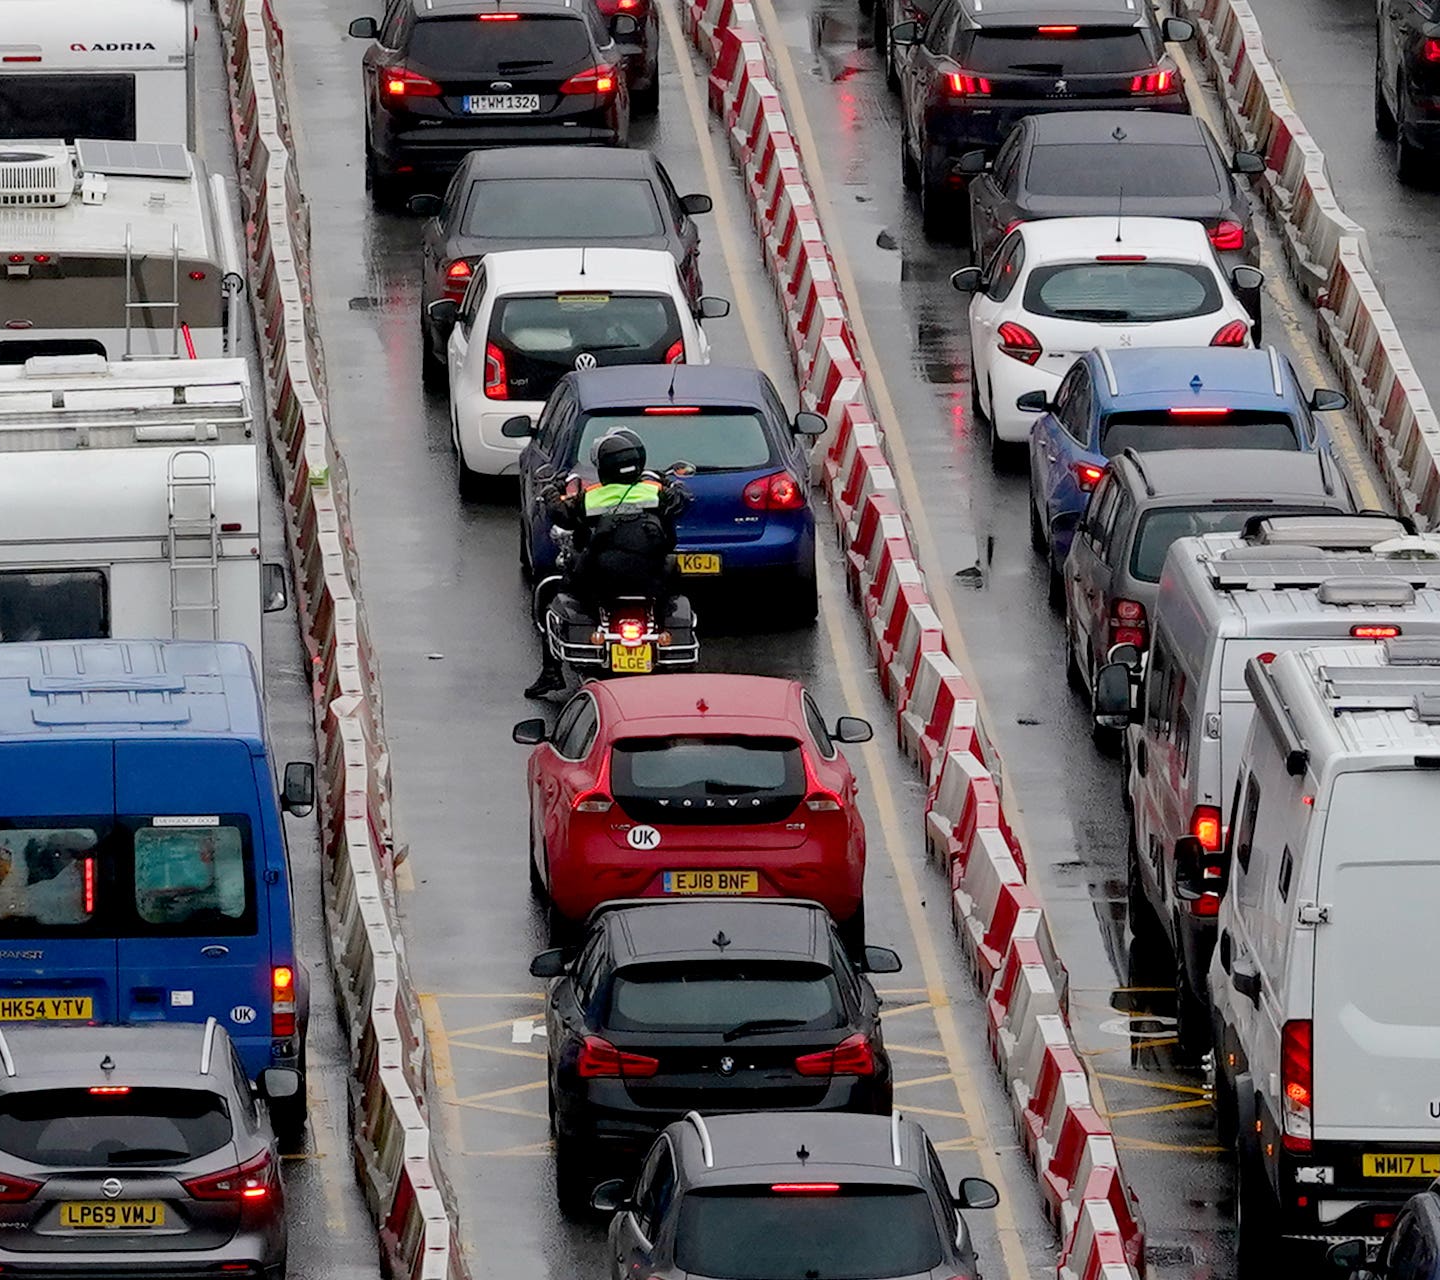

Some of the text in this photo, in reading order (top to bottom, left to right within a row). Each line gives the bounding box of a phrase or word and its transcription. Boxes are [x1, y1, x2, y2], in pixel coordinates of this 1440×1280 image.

[92, 41, 156, 52] ADRIA
[618, 658, 645, 669] LGE
[658, 798, 761, 806] VOLVO
[632, 830, 654, 845] UK
[676, 875, 750, 889] EJ18 BNF
[1, 1000, 86, 1017] HK54 YTV
[234, 1009, 252, 1021] UK
[1374, 1156, 1416, 1174] WM17
[68, 1206, 157, 1225] LP69 VMJ
